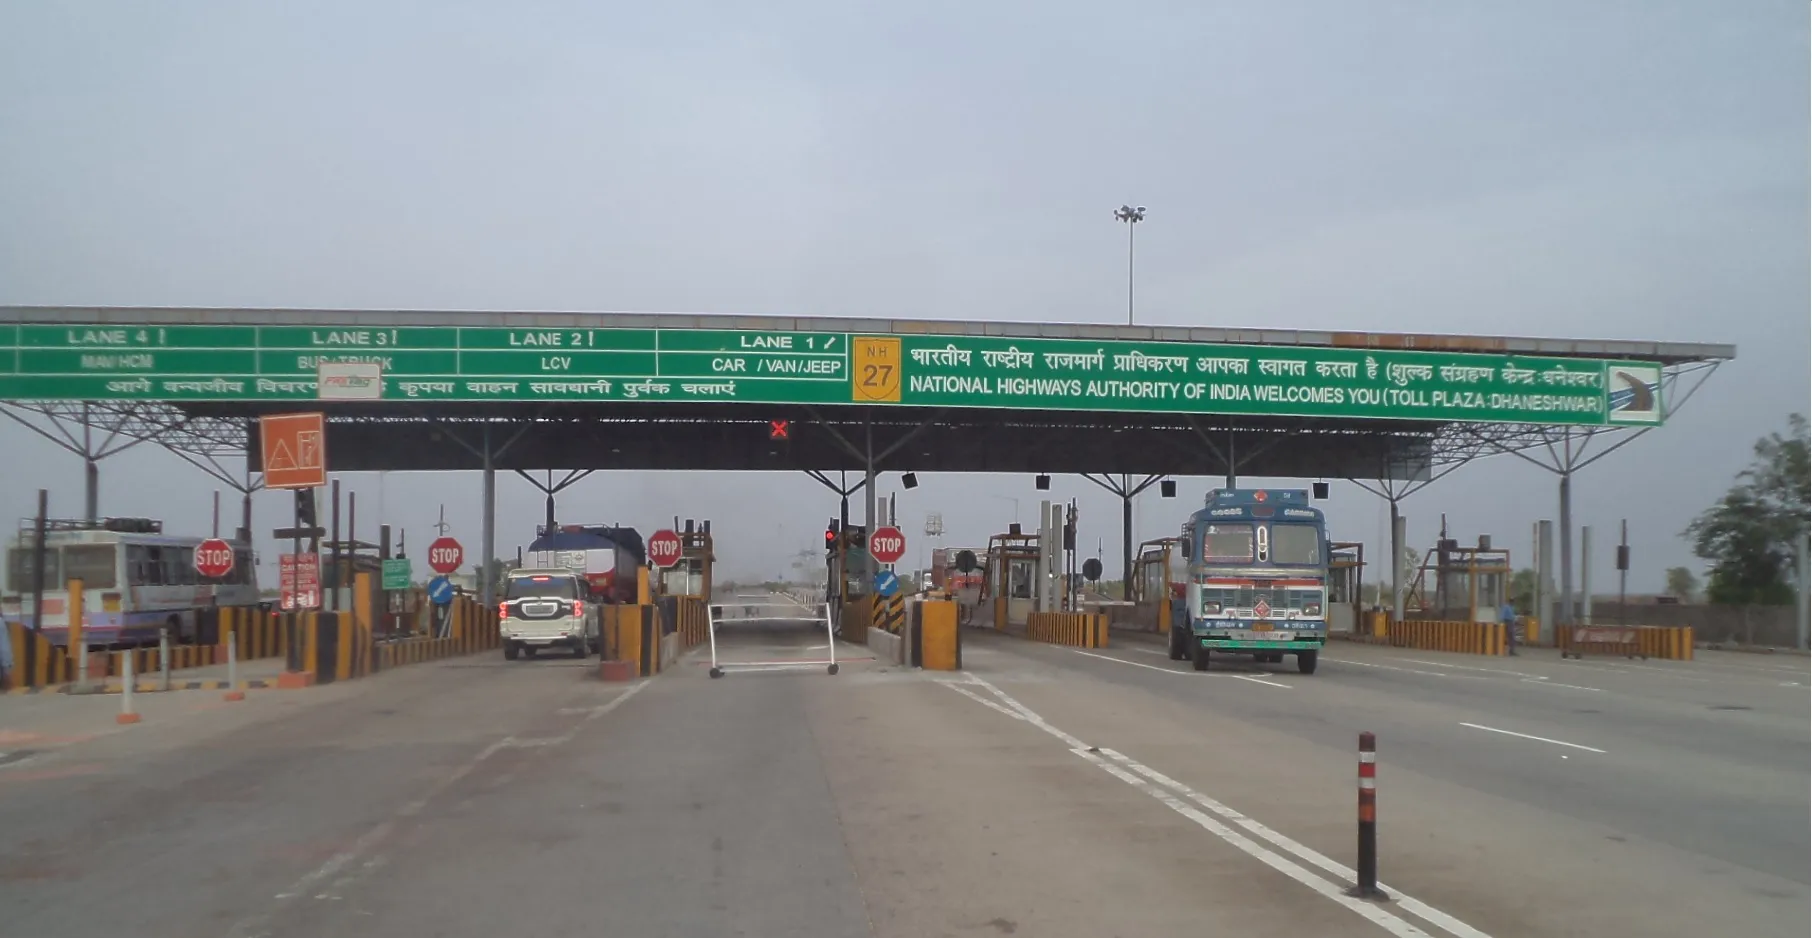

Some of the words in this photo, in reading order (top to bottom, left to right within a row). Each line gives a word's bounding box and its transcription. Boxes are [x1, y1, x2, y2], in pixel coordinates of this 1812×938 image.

[68, 330, 127, 344] LANE
[136, 330, 148, 343] 4
[312, 331, 370, 345] LANE
[376, 332, 387, 346] 3
[509, 332, 562, 346] LANE
[571, 332, 581, 346] 2
[741, 336, 792, 348] LANE
[806, 338, 813, 349] 1
[542, 357, 571, 370] LCV
[712, 358, 746, 372] CAR
[910, 344, 972, 366] भारतीय
[981, 346, 1034, 369] राष्ट्रीय
[1043, 348, 1105, 370] राजमार्ग
[1113, 351, 1189, 373] प्राधिकरण
[1196, 357, 1249, 375] आपका
[1258, 359, 1307, 377] स्वागत
[1315, 361, 1358, 378] करता
[1366, 356, 1379, 379] है
[1440, 363, 1494, 383] संग्रहण
[863, 365, 893, 387] 27
[106, 378, 152, 393] आगे
[163, 378, 244, 393] वन्यजीव
[399, 381, 455, 397] कृपया
[466, 382, 519, 394] वाहन
[529, 379, 612, 394] सावधानी
[681, 380, 736, 395] चलाएं
[910, 376, 992, 393] NATIONAL
[998, 378, 1082, 396] HIGHWAYS
[1086, 380, 1180, 398] AUTHORITY
[1184, 383, 1206, 399] OF
[1210, 384, 1251, 401] INDIA
[1254, 385, 1344, 404] WELCOMES
[1348, 388, 1379, 405] YOU
[651, 540, 678, 556] STOP
[874, 538, 901, 552] STOP
[197, 549, 230, 565] STOP
[432, 548, 459, 563] STOP
